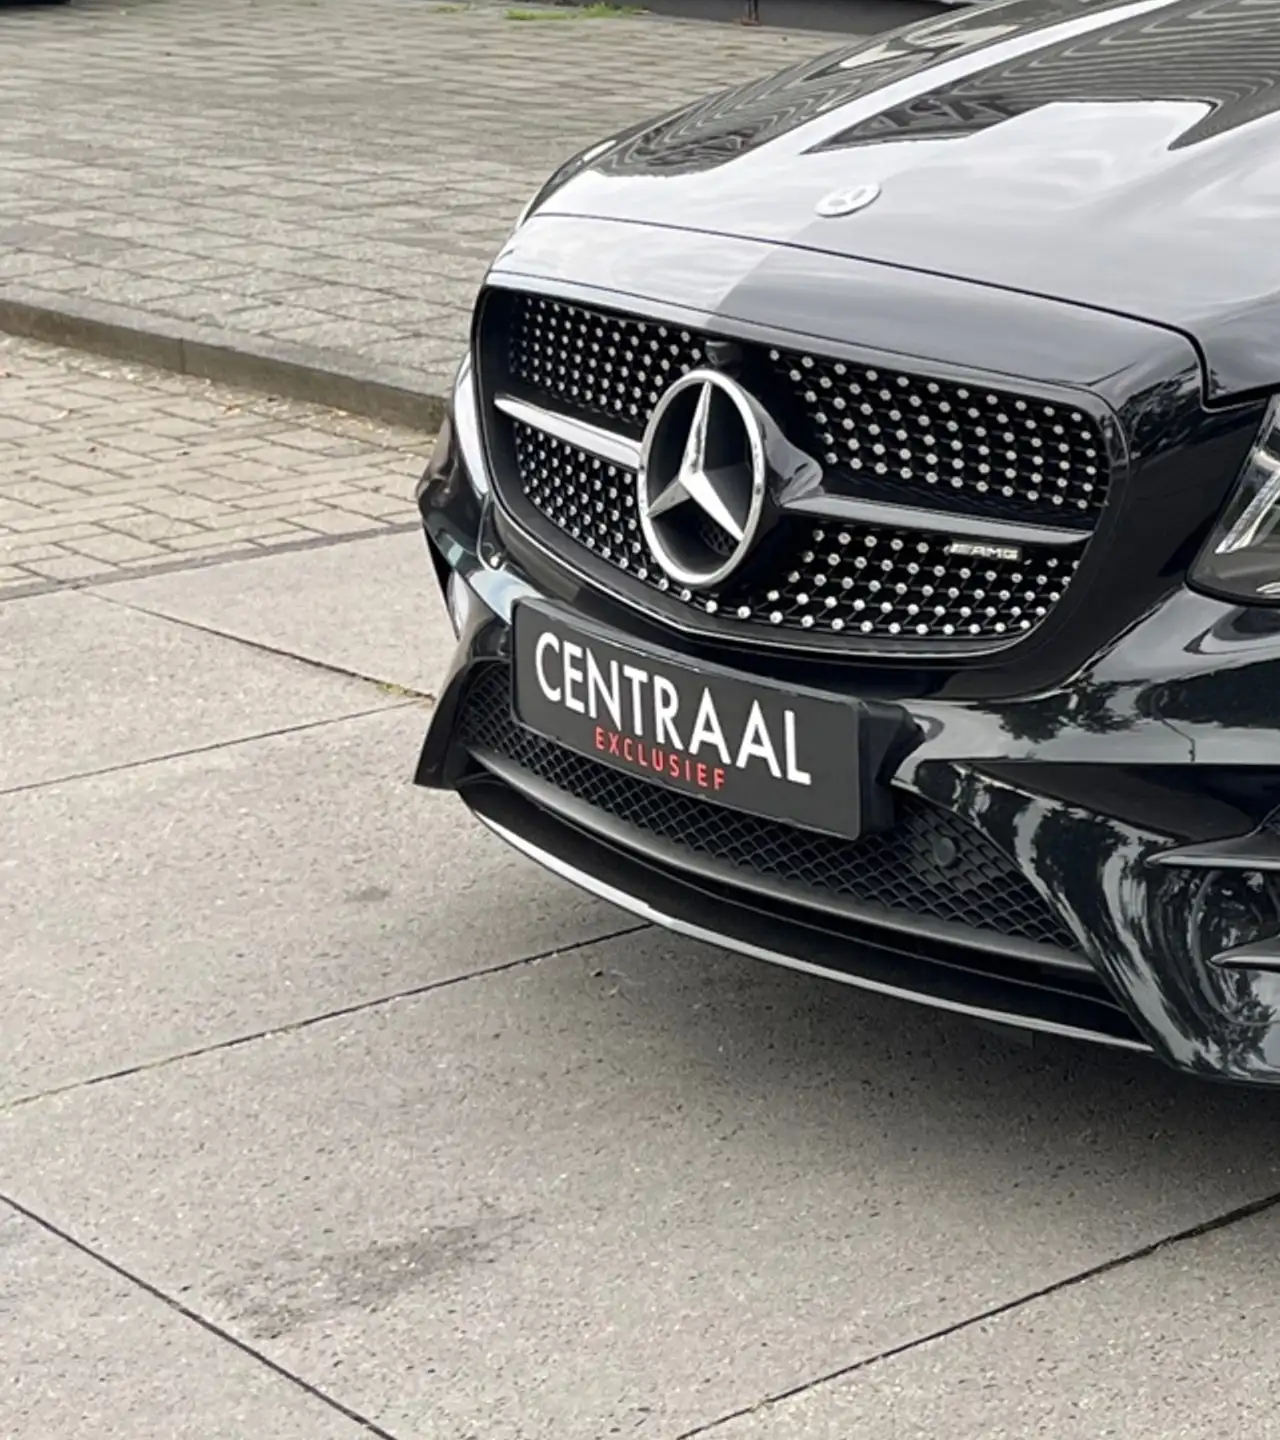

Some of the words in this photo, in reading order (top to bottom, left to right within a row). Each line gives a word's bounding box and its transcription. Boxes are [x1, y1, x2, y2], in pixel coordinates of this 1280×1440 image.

[969, 545, 1018, 560] AMG
[535, 632, 812, 785] CENTRAAL
[595, 727, 726, 791] EXCLUSIEF
